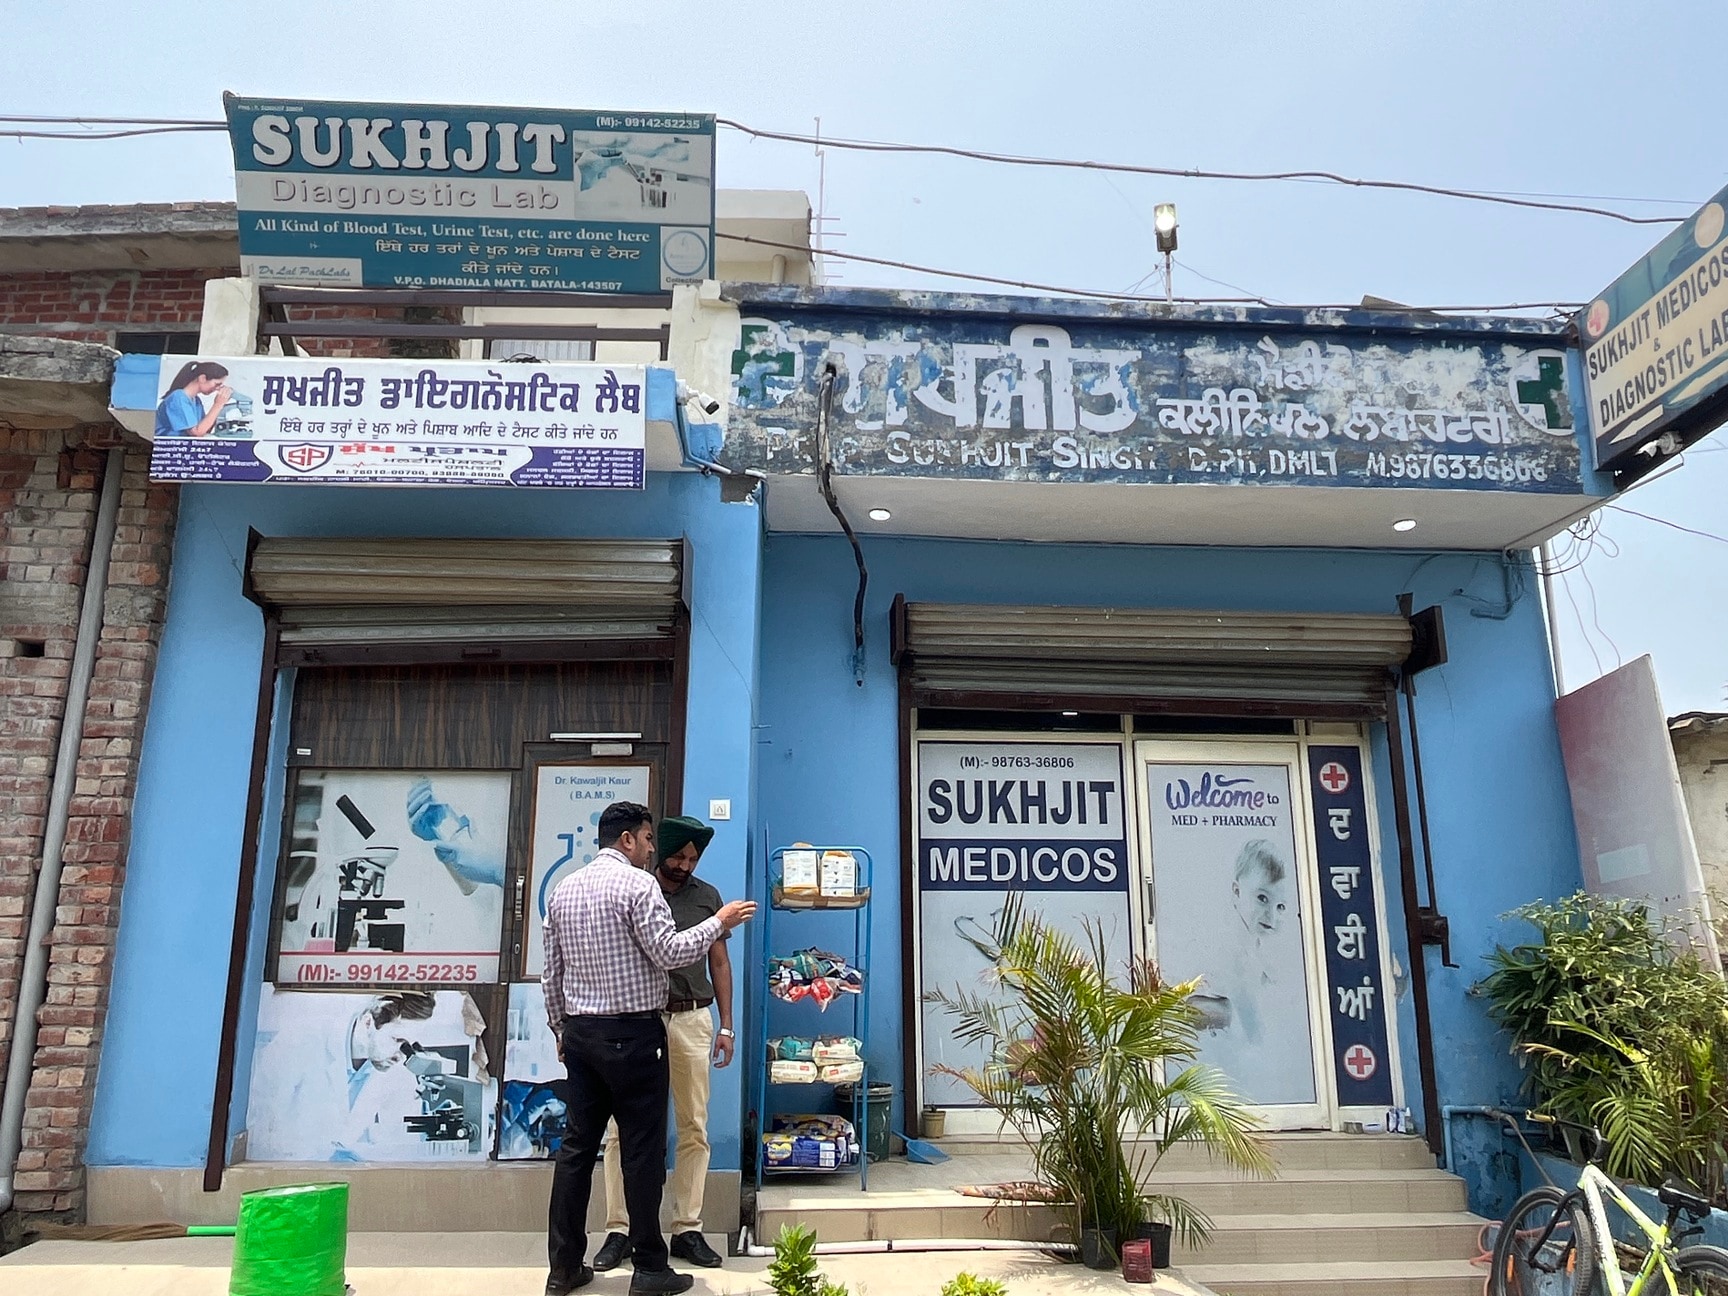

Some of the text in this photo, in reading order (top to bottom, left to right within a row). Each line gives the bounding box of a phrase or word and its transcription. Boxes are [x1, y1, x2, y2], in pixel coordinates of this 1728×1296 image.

[252, 114, 567, 174] SUKHJIT
[272, 177, 560, 210] Diagnostic Lab
[255, 219, 651, 243] All Kind of Blood Test, Urine Test, etc. are done here
[408, 243, 429, 253] ਹਰ
[469, 241, 481, 255] ਦੇ
[514, 243, 541, 257] ਅਤੇ
[590, 244, 602, 258] ਦੇ
[608, 245, 641, 260] ਟੈਸਟ
[276, 266, 297, 276] Lal
[300, 266, 351, 277] PathLabs
[461, 260, 490, 274] ਕੀਤੇ
[496, 262, 524, 275] ਜਾਂਦੇ
[394, 276, 426, 286] V.P.O.
[430, 277, 491, 288] DHADIALA
[531, 279, 623, 292] BATALA-143507
[1589, 246, 1728, 381] SUKHJIT MEDICOS
[1653, 337, 1661, 352] &
[262, 366, 641, 415] ਸੁਖਜੀਤ ਡਾਇਗਨੋਸਟਿਕ ਲੈਬ
[1600, 337, 1695, 428] DIAGNOSTIC
[279, 417, 301, 434] ਇੱਥੇ
[308, 421, 325, 434] ਹਰ
[357, 418, 368, 435] ਦੇ
[395, 418, 418, 435] ਅਤੇ
[463, 421, 493, 437] ਆਦਿ
[497, 422, 507, 438] ਦੇ
[512, 422, 540, 439] ਟੈਸਟ
[545, 423, 568, 440] ਕੀਤੇ
[573, 423, 595, 440] ਜਾਂਦੇ
[601, 427, 618, 440] ਹਨ
[959, 756, 1075, 769] (M):- 98763-36806
[555, 776, 632, 787] Dr. Kawaljit Kaur
[1165, 771, 1280, 811] Welcome to
[928, 779, 1116, 825] SUKHJIT
[1171, 815, 1198, 827] MED
[1212, 815, 1278, 827] PHARMACY
[929, 847, 1118, 883] MEDICOS
[297, 964, 477, 982] (M):- 99142-52235
